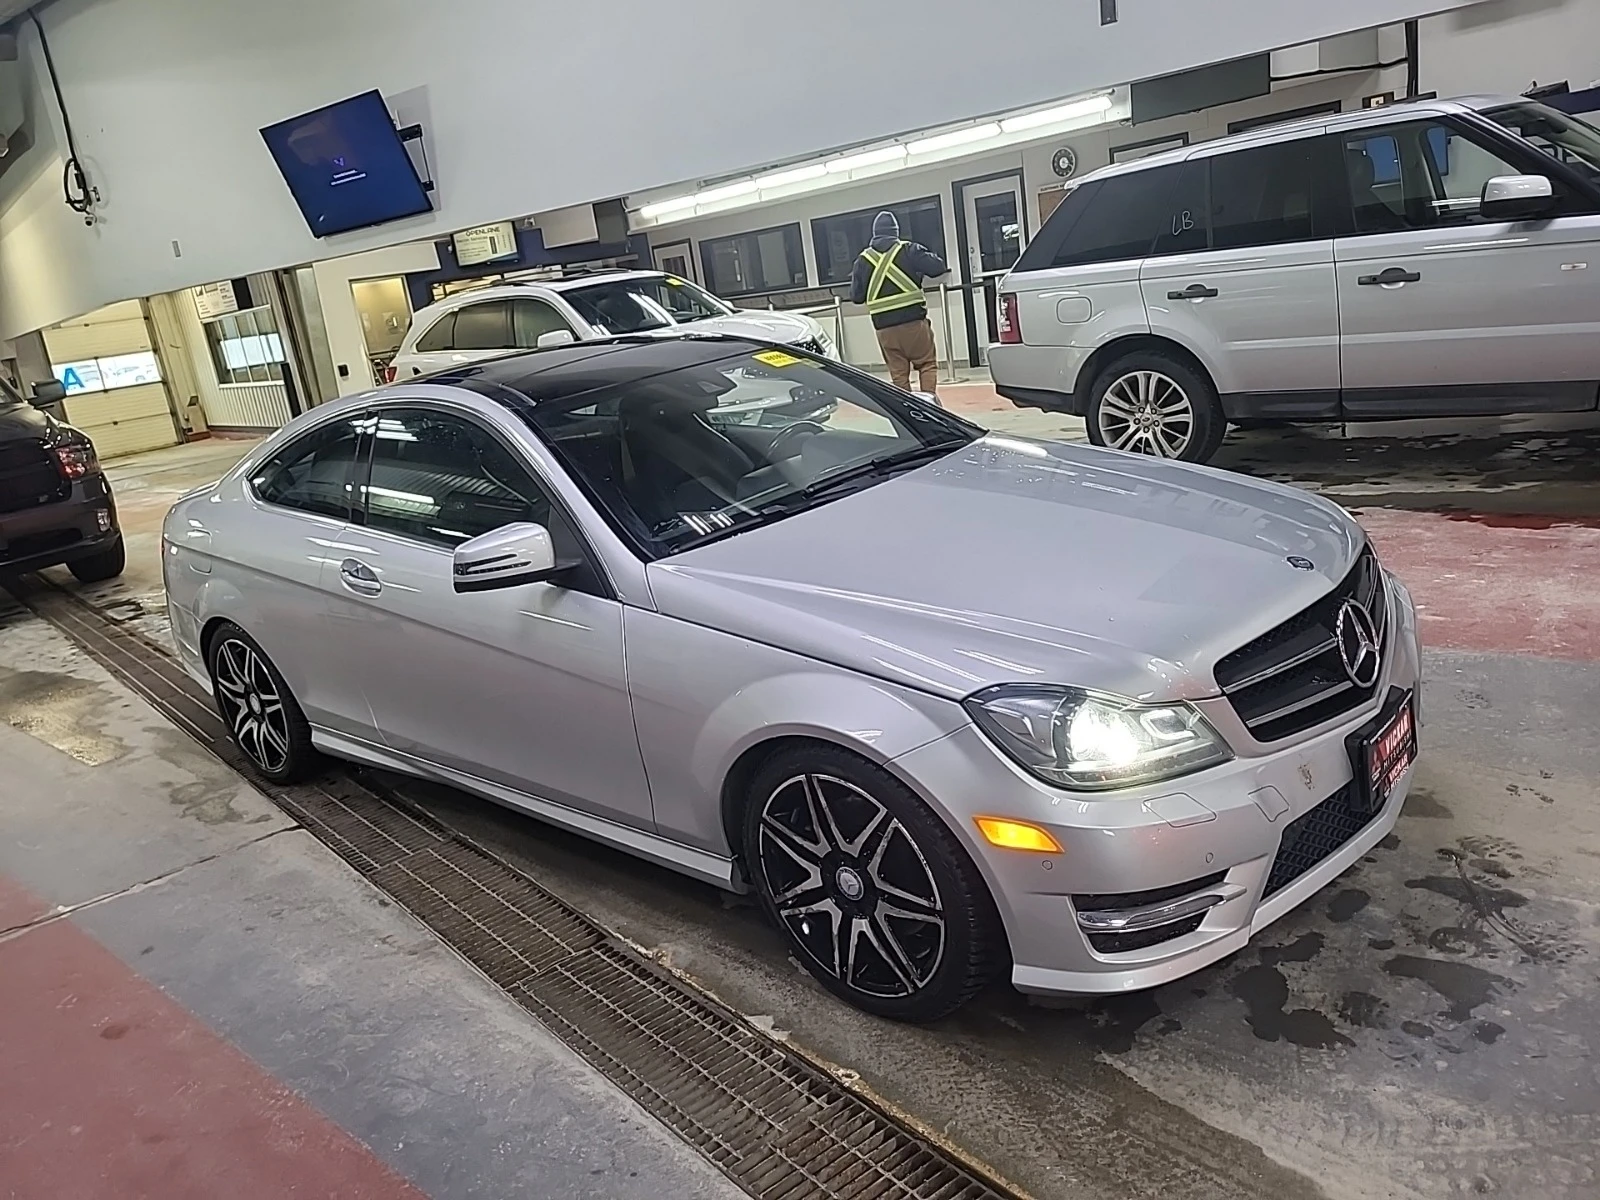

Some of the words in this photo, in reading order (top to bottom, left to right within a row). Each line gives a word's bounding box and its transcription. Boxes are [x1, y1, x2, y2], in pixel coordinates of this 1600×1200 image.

[465, 226, 500, 237] OPENLANE
[1172, 210, 1194, 236] LB
[1385, 713, 1409, 755] VICKAR
